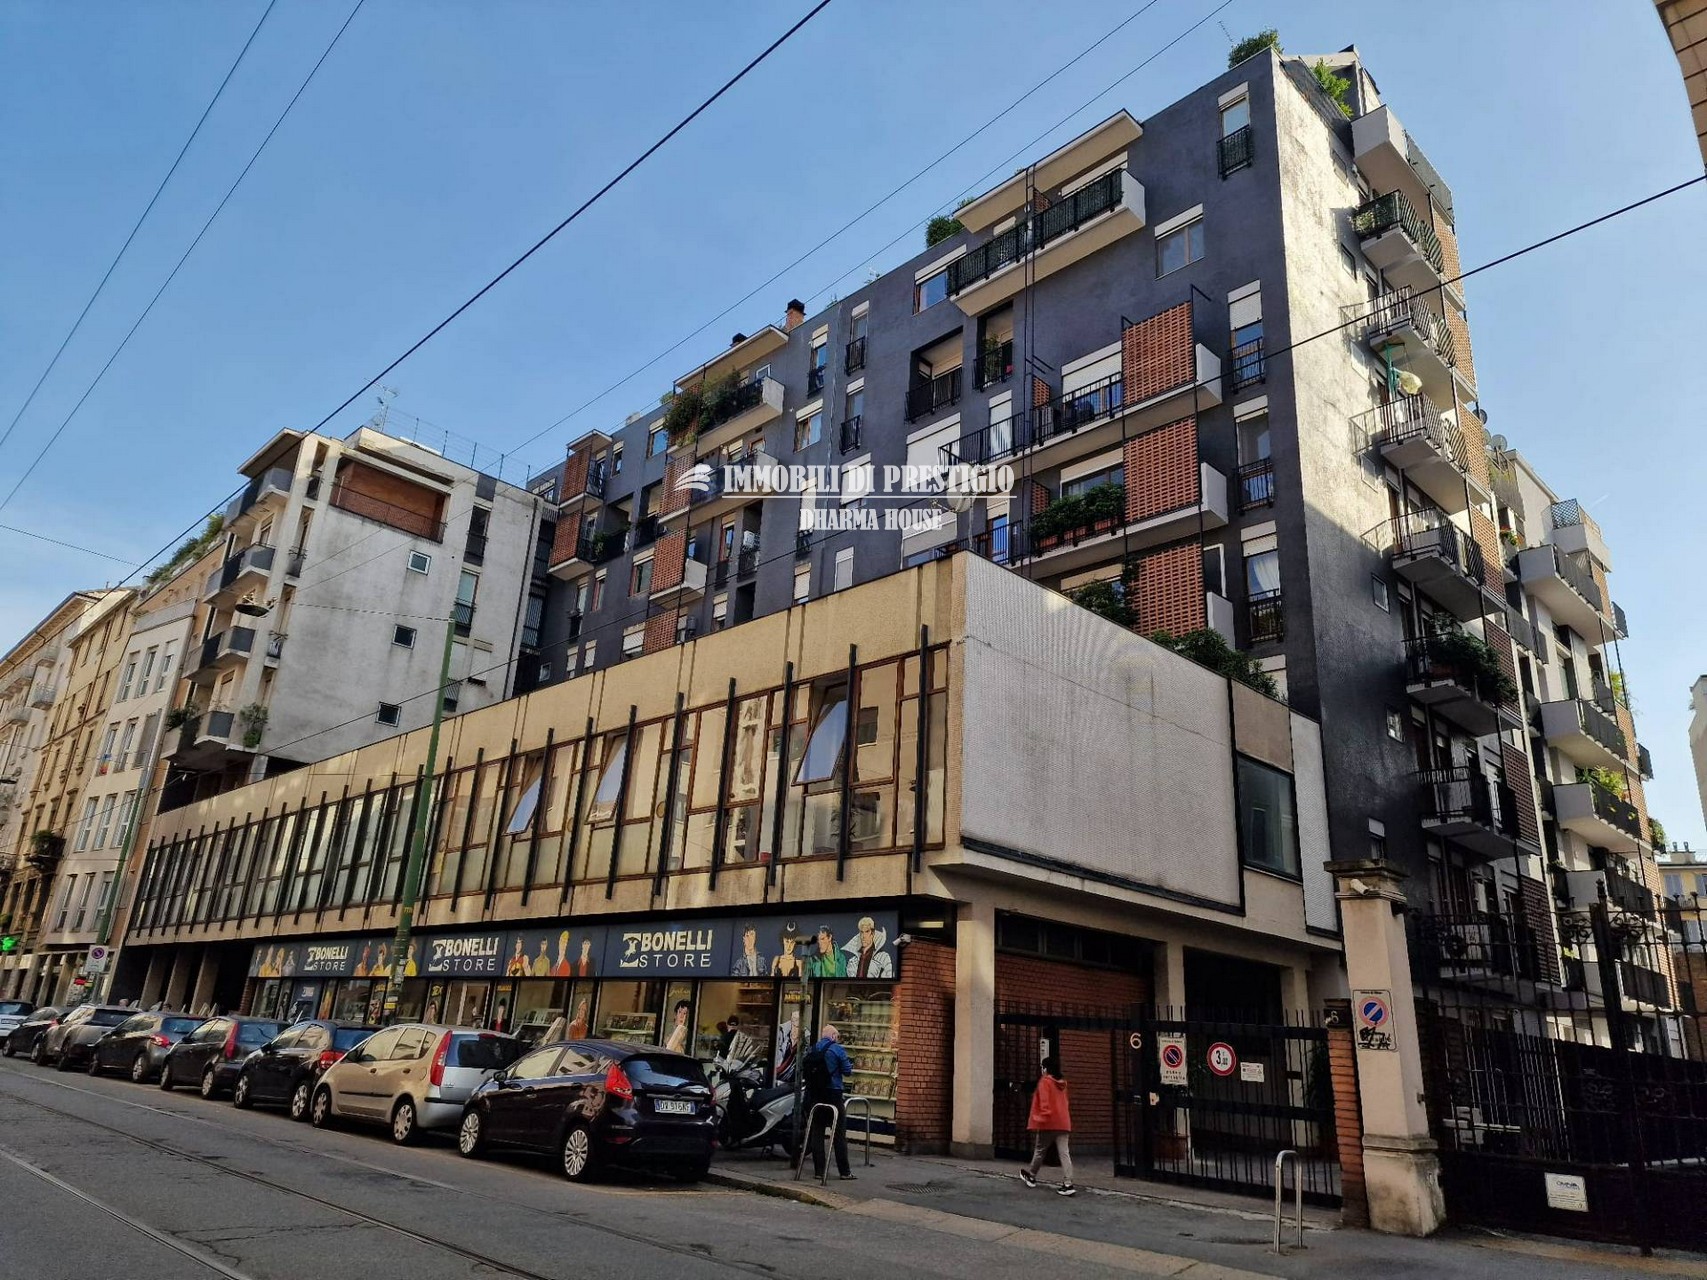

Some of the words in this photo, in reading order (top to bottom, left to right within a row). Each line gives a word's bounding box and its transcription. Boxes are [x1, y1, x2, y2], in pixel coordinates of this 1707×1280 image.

[444, 937, 499, 957] BONELLI
[641, 929, 713, 952] BONELLI
[314, 945, 349, 961] BONELLI
[639, 953, 712, 968] STORE
[312, 961, 346, 971] STORE
[442, 958, 496, 972] STORE
[1129, 1032, 1142, 1050] 6
